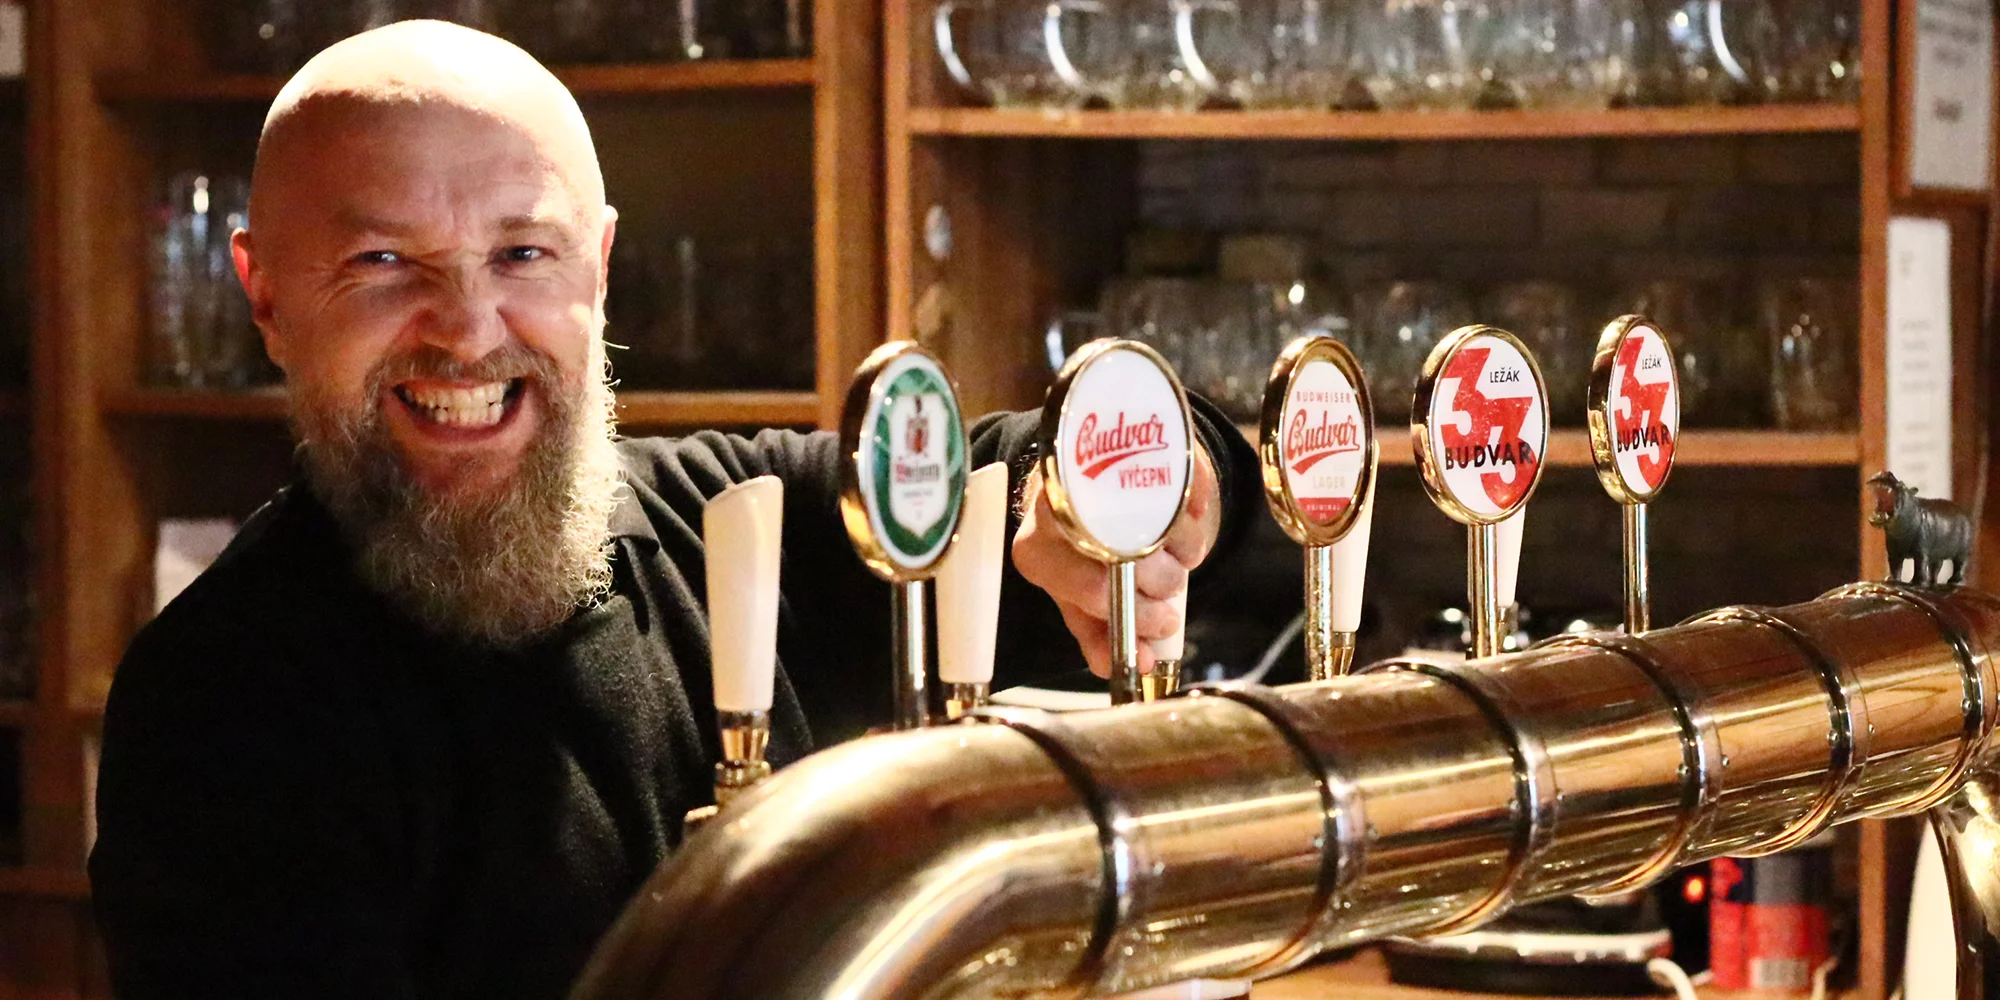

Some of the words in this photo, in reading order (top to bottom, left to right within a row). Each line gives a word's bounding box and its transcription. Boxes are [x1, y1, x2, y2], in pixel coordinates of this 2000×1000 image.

[1642, 354, 1662, 370] LEŽÁK
[1489, 367, 1520, 383] LEŽÁK
[1296, 390, 1352, 404] BUDWEISER
[1075, 411, 1169, 467] Budvar
[1287, 408, 1361, 461] Budvar
[1617, 424, 1671, 454] BUDVAR
[1445, 441, 1533, 470] BUDVAR
[1312, 475, 1346, 490] LAGER
